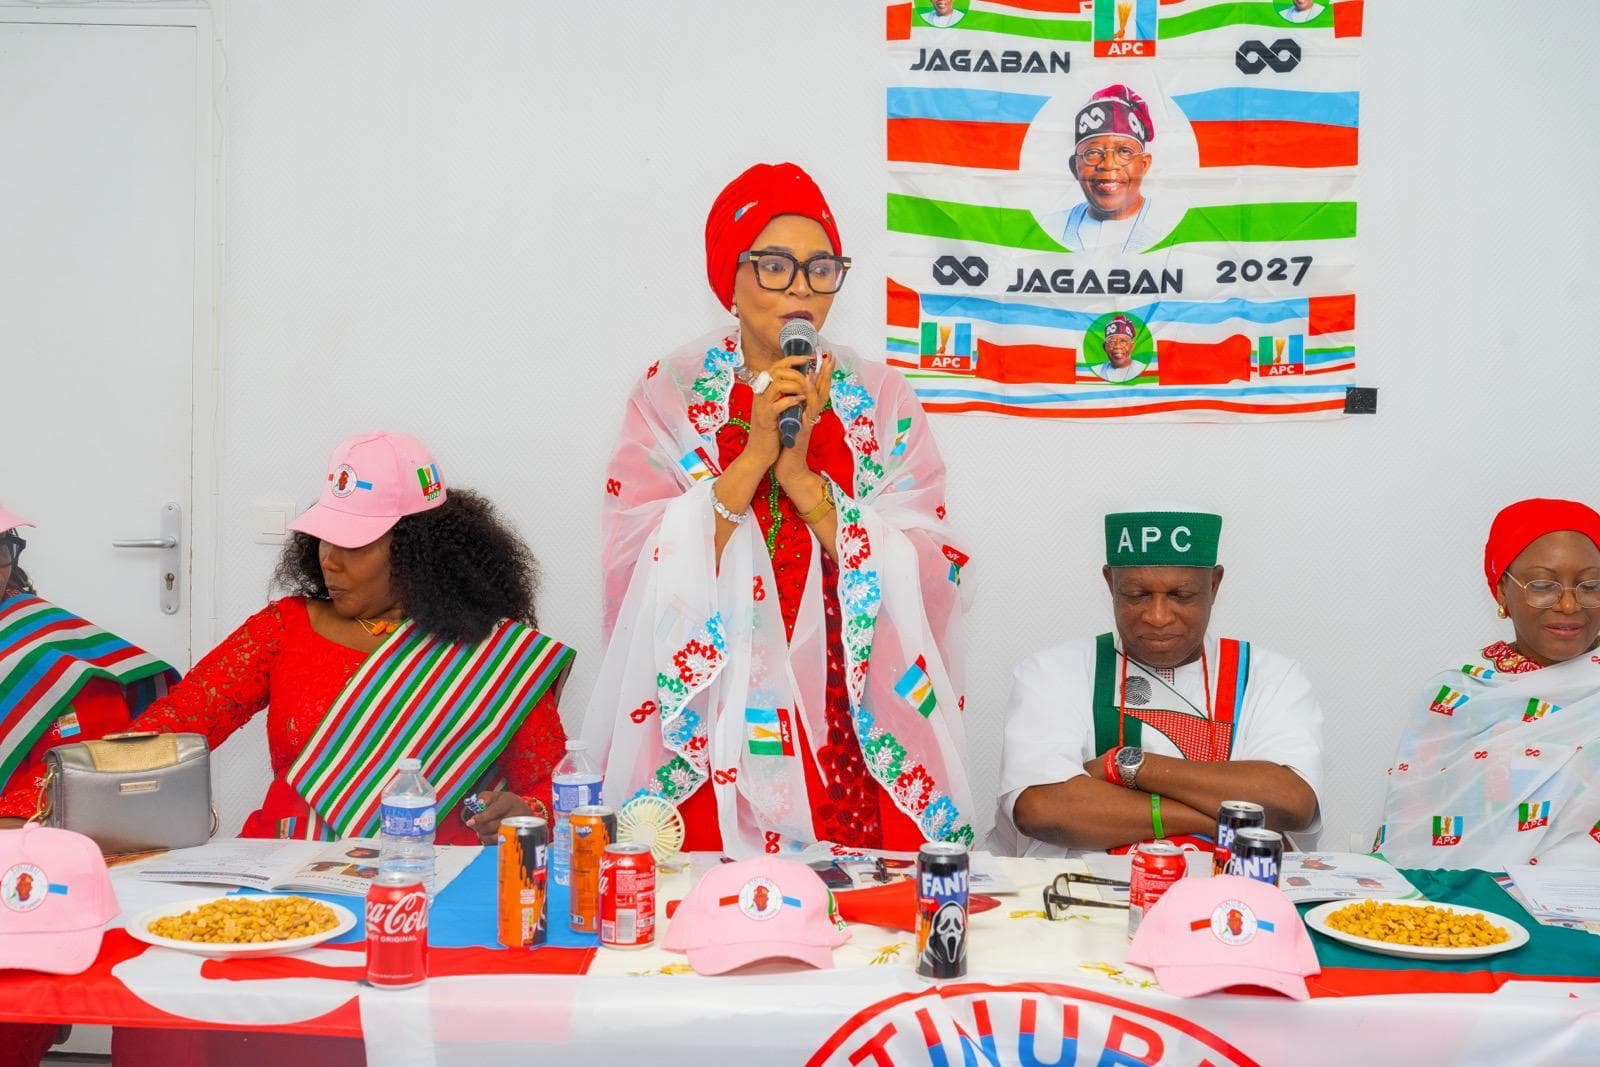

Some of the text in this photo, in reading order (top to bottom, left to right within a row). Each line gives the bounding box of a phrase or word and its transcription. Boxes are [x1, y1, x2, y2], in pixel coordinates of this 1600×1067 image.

[1107, 42, 1144, 56] APC
[910, 47, 1071, 74] JAGABAN
[1006, 256, 1313, 294] JAGABAN 2027
[931, 356, 961, 369] APC
[1269, 364, 1295, 376] APC
[1117, 526, 1192, 553] APC
[1431, 703, 1452, 715] APC
[781, 720, 790, 744] APC
[1522, 818, 1543, 830] APC
[1435, 836, 1457, 845] APC
[921, 868, 968, 897] FANT
[848, 998, 1218, 1067] TINUB
